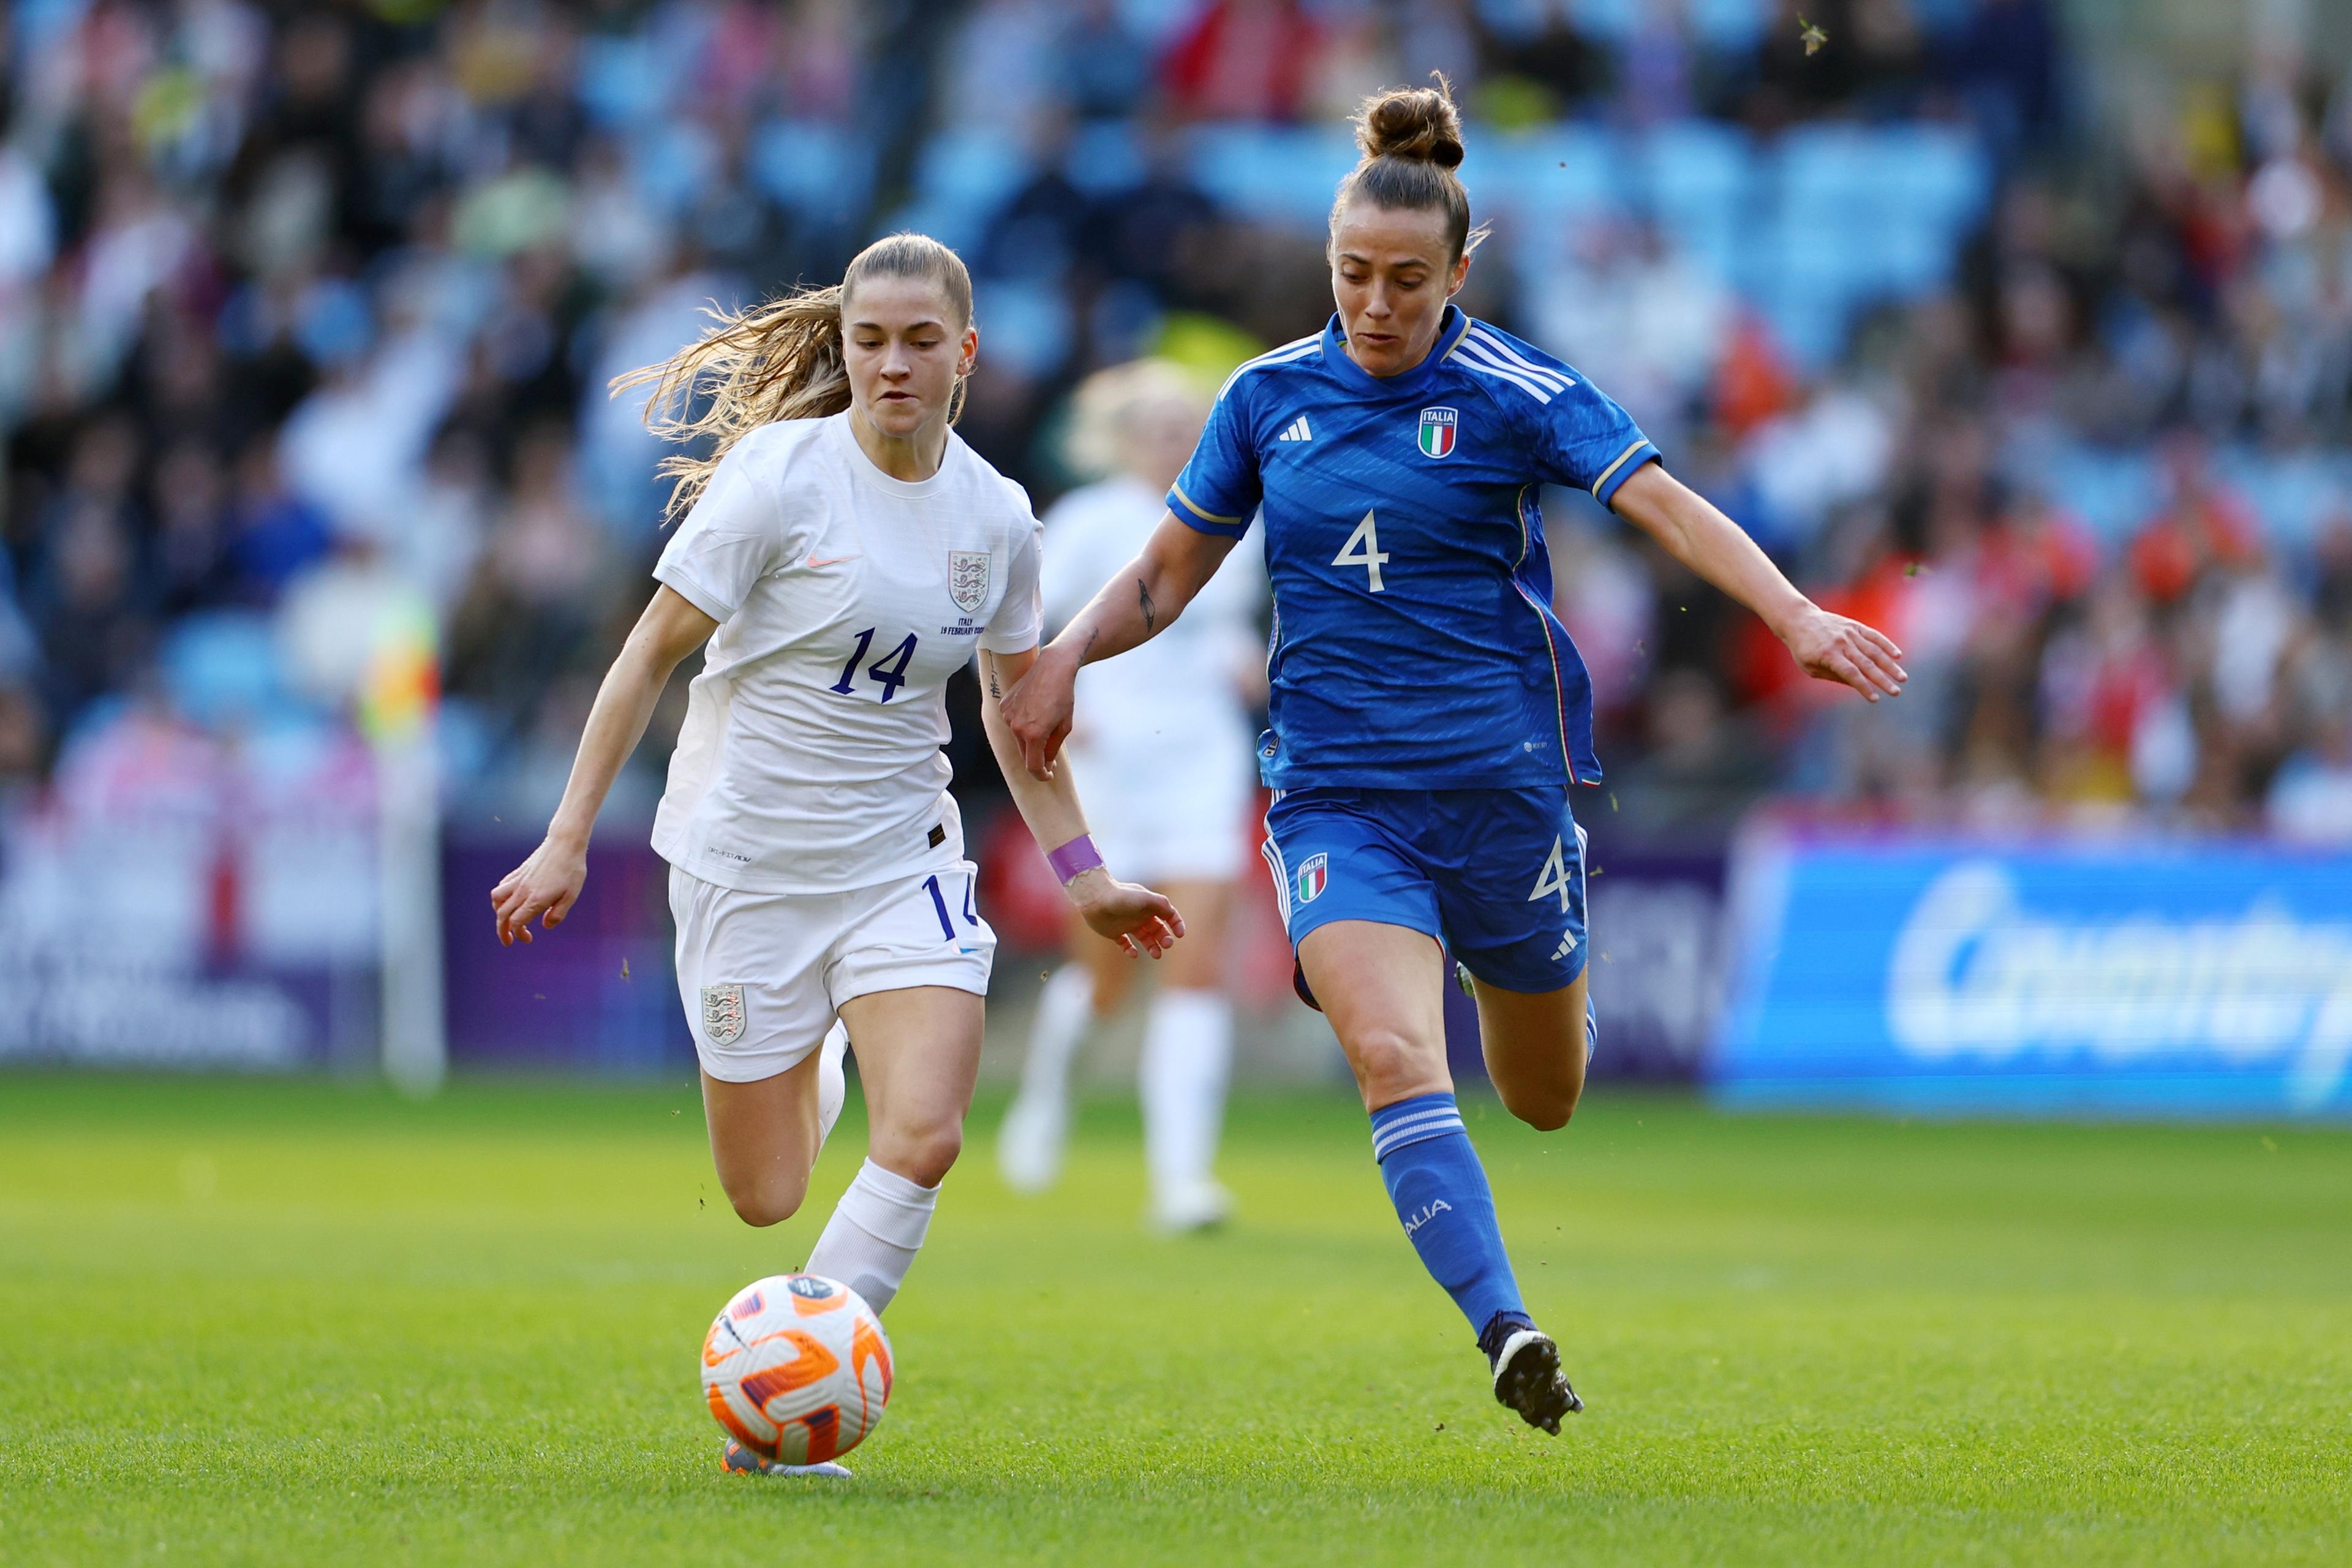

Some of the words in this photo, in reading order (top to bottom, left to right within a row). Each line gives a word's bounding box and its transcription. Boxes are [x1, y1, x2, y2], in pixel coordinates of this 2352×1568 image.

[1423, 411, 1454, 422] ITALIA
[1331, 508, 1389, 593] 4
[941, 626, 948, 635] 19
[948, 627, 974, 635] FEBRUARY
[829, 627, 918, 704] 14
[1300, 856, 1324, 876] ITALIA
[1528, 832, 1572, 914] 4
[1405, 1199, 1452, 1240] ALIA
